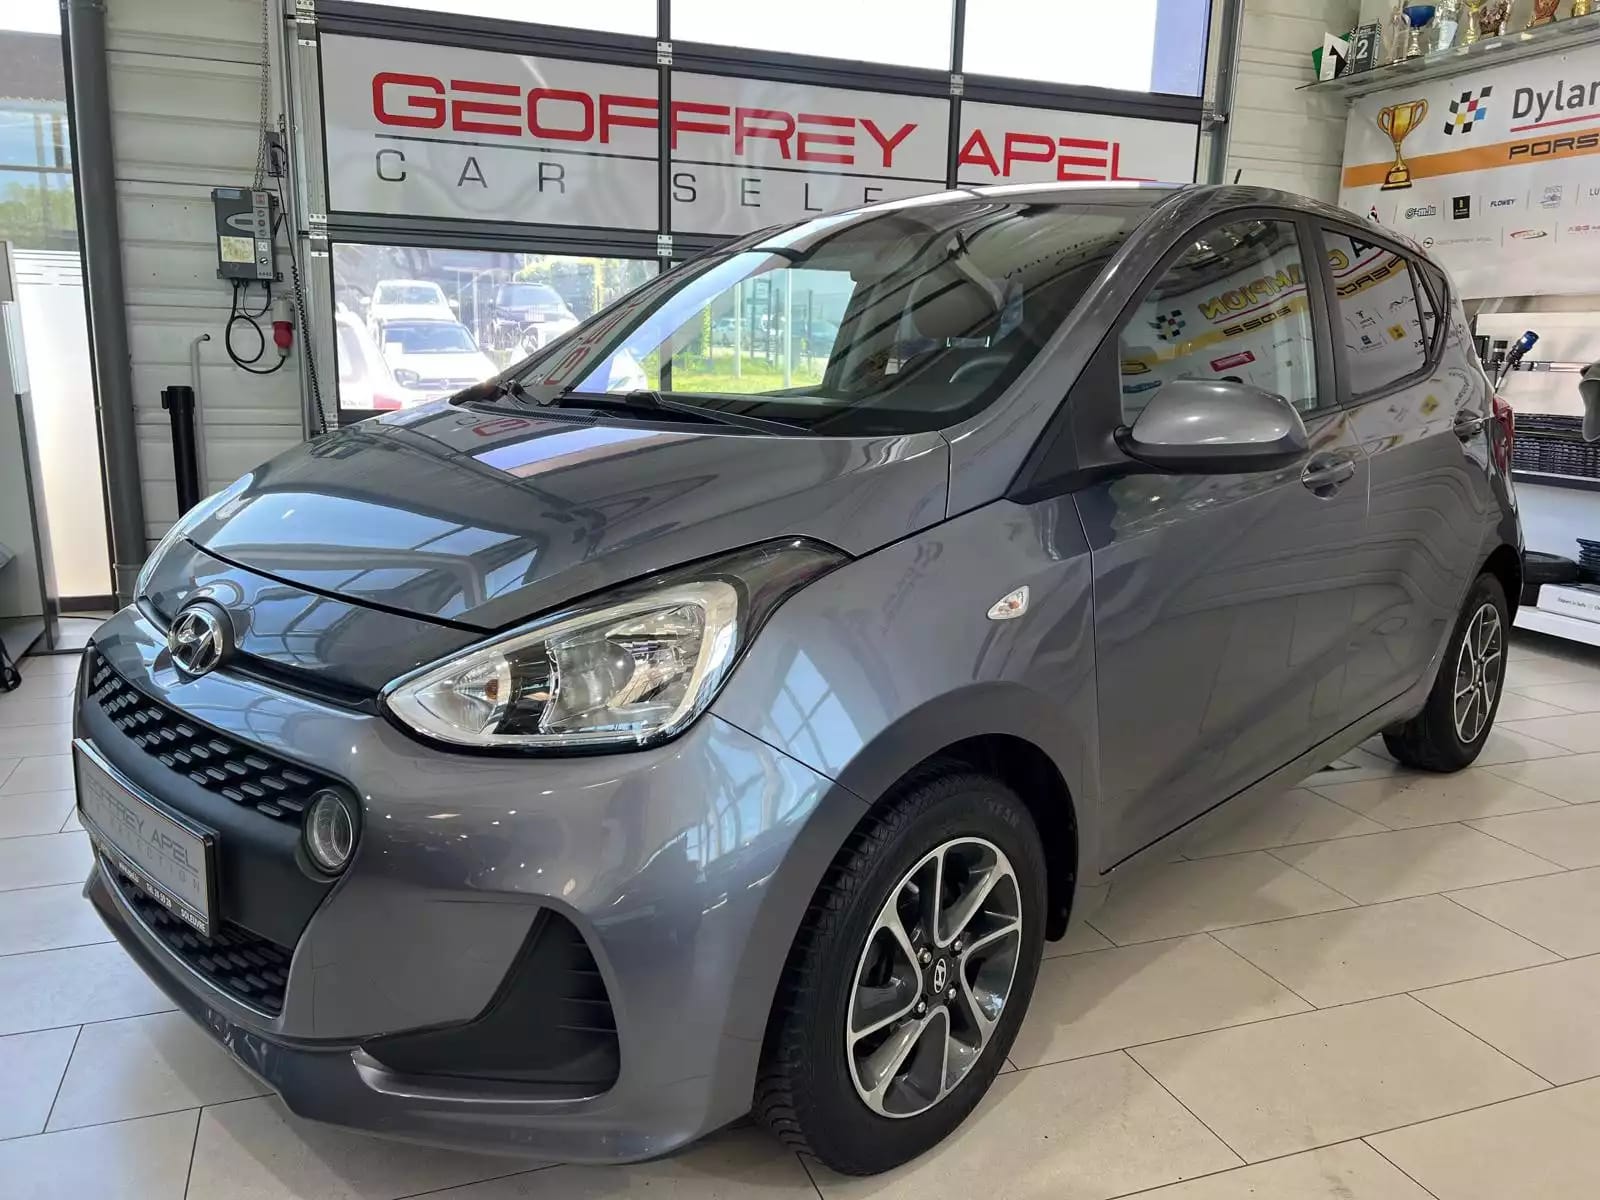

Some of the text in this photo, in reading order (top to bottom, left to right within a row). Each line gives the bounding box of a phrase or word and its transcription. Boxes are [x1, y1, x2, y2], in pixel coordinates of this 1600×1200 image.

[1356, 39, 1369, 59] 2
[372, 70, 1158, 182] GEOFFREY APEL
[375, 149, 566, 194] CAR
[151, 828, 199, 874] APEL
